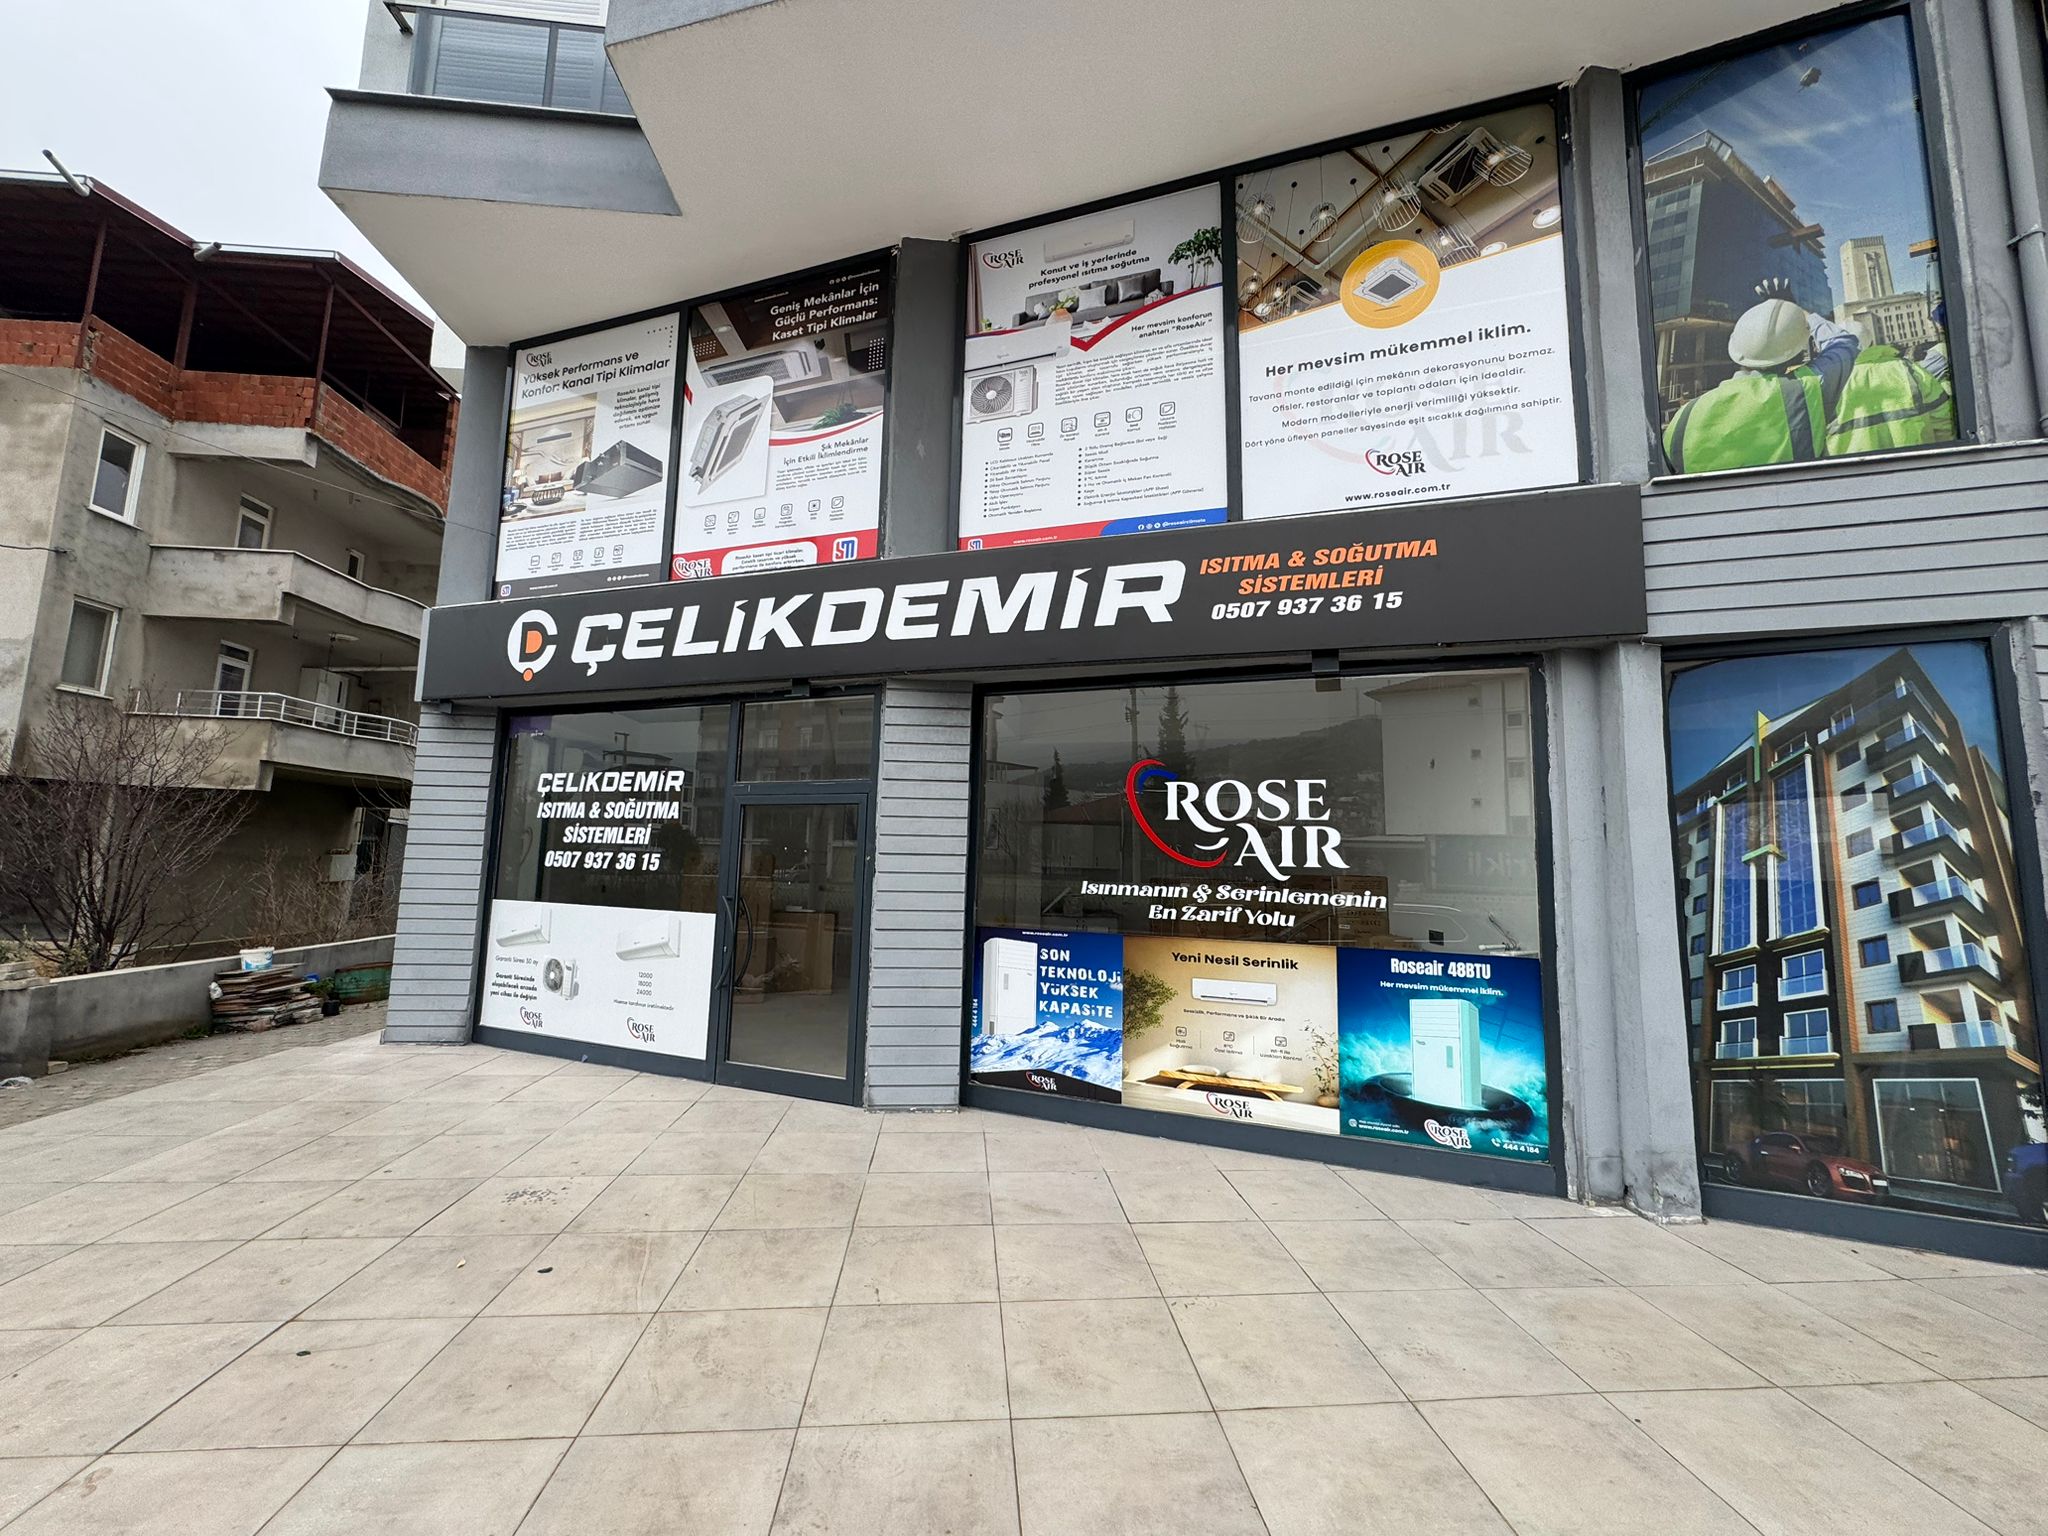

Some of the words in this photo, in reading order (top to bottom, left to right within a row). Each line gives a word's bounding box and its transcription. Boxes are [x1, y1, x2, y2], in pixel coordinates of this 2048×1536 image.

[989, 249, 1022, 265] ROSE
[1001, 256, 1024, 269] AIR
[1040, 265, 1067, 277] Konut
[1082, 258, 1089, 269] iş
[1091, 249, 1137, 267] yerlerinde
[1028, 271, 1080, 290] profesyonel
[1081, 265, 1108, 278] ısıtma
[1110, 256, 1150, 273] soğutma
[770, 302, 801, 316] Geniş
[804, 289, 856, 307] Mekânlar
[860, 282, 879, 297] İçin
[775, 312, 806, 328] Güçlü
[809, 297, 878, 320] Performans:
[1178, 312, 1212, 322] konforun
[772, 327, 804, 341] Kaset
[807, 320, 827, 334] Tipi
[830, 309, 878, 327] Klimalar
[531, 352, 551, 364] ROSE
[1266, 363, 1294, 378] Her
[1298, 352, 1365, 373] mevsim
[1370, 332, 1473, 360] mükemmel
[1478, 324, 1531, 341] iklim.
[522, 384, 560, 399] Konfor:
[562, 376, 594, 389] Kanal
[596, 368, 616, 384] Tipi
[619, 359, 670, 377] Klimalar
[524, 369, 560, 385] Yüksek
[562, 356, 622, 377] Performans
[1249, 392, 1282, 403] Tavana
[1284, 386, 1316, 398] monte
[1318, 378, 1354, 393] edildiği
[1356, 375, 1374, 388] için
[1376, 367, 1420, 382] mekânın
[1423, 355, 1505, 376] dekorasyonunu
[1508, 348, 1555, 361] bozmaz.
[1272, 402, 1304, 413] Ofisler,
[1306, 393, 1360, 408] restoranlar
[1376, 385, 1416, 398] toplantı
[1419, 377, 1457, 390] odaları
[1459, 373, 1479, 386] için
[1481, 366, 1526, 380] idealdir.
[1281, 414, 1319, 428] Modern
[1321, 406, 1382, 423] modelleriyle
[1384, 402, 1413, 415] enerji
[1415, 393, 1468, 410] verimliliği
[1470, 385, 1520, 401] yüksektir.
[1321, 426, 1358, 439] paneller
[1360, 418, 1406, 433] sayesinde
[1408, 416, 1426, 426] eşit
[1427, 411, 1463, 422] sıcaklık
[1464, 403, 1518, 418] dağılımına
[1520, 396, 1562, 411] sahiptir.
[1376, 450, 1422, 471] ROSE
[1395, 462, 1427, 477] AIR
[1344, 482, 1451, 503] www.roseair.com.tr
[680, 559, 710, 573] ROSE
[1200, 552, 1280, 575] ISITMA
[1287, 550, 1306, 568] &
[1313, 539, 1438, 566] SOĞUTMA
[1238, 565, 1384, 595] SİSTEMLERİ
[1211, 600, 1271, 620] 0507
[1277, 597, 1324, 616] 937
[1330, 594, 1362, 613] 36
[1373, 591, 1403, 609] 15
[570, 559, 1187, 676] ÇELİKDEMİR
[537, 770, 685, 797] ÇELİKDEMİR
[537, 802, 585, 819] ISITMA
[589, 802, 601, 819] &
[604, 798, 679, 819] SOĞUTMA
[1164, 779, 1331, 833] ROSE
[563, 823, 652, 845] SİSTEMLERİ
[544, 851, 582, 868] 0507
[583, 852, 613, 869] 937
[615, 852, 637, 870] 36
[641, 853, 661, 871] 15
[1233, 822, 1350, 881] AIR
[1081, 880, 1188, 898] Isınmanın
[1192, 883, 1212, 903] &
[1215, 884, 1387, 909] Serinlemenin
[1149, 904, 1177, 921] En
[1180, 905, 1241, 923] Zarif
[1246, 910, 1296, 928] Yolu
[1040, 949, 1070, 962] SON
[1171, 952, 1201, 963] Yeni
[1204, 954, 1239, 966] Nesil
[1242, 957, 1299, 970] Serinlik
[1391, 958, 1444, 976] Roseair
[1447, 961, 1491, 980] 48BTU
[1430, 984, 1479, 995] mükemmel
[632, 1023, 654, 1033] ROSE
[641, 1032, 655, 1043] AIR
[1031, 1074, 1055, 1085] ROSE
[1041, 1080, 1057, 1091] AIR
[1214, 1097, 1250, 1110] ROSE
[1230, 1107, 1253, 1119] AIR
[1434, 1126, 1466, 1138] ROSE
[1448, 1137, 1469, 1147] AIR
